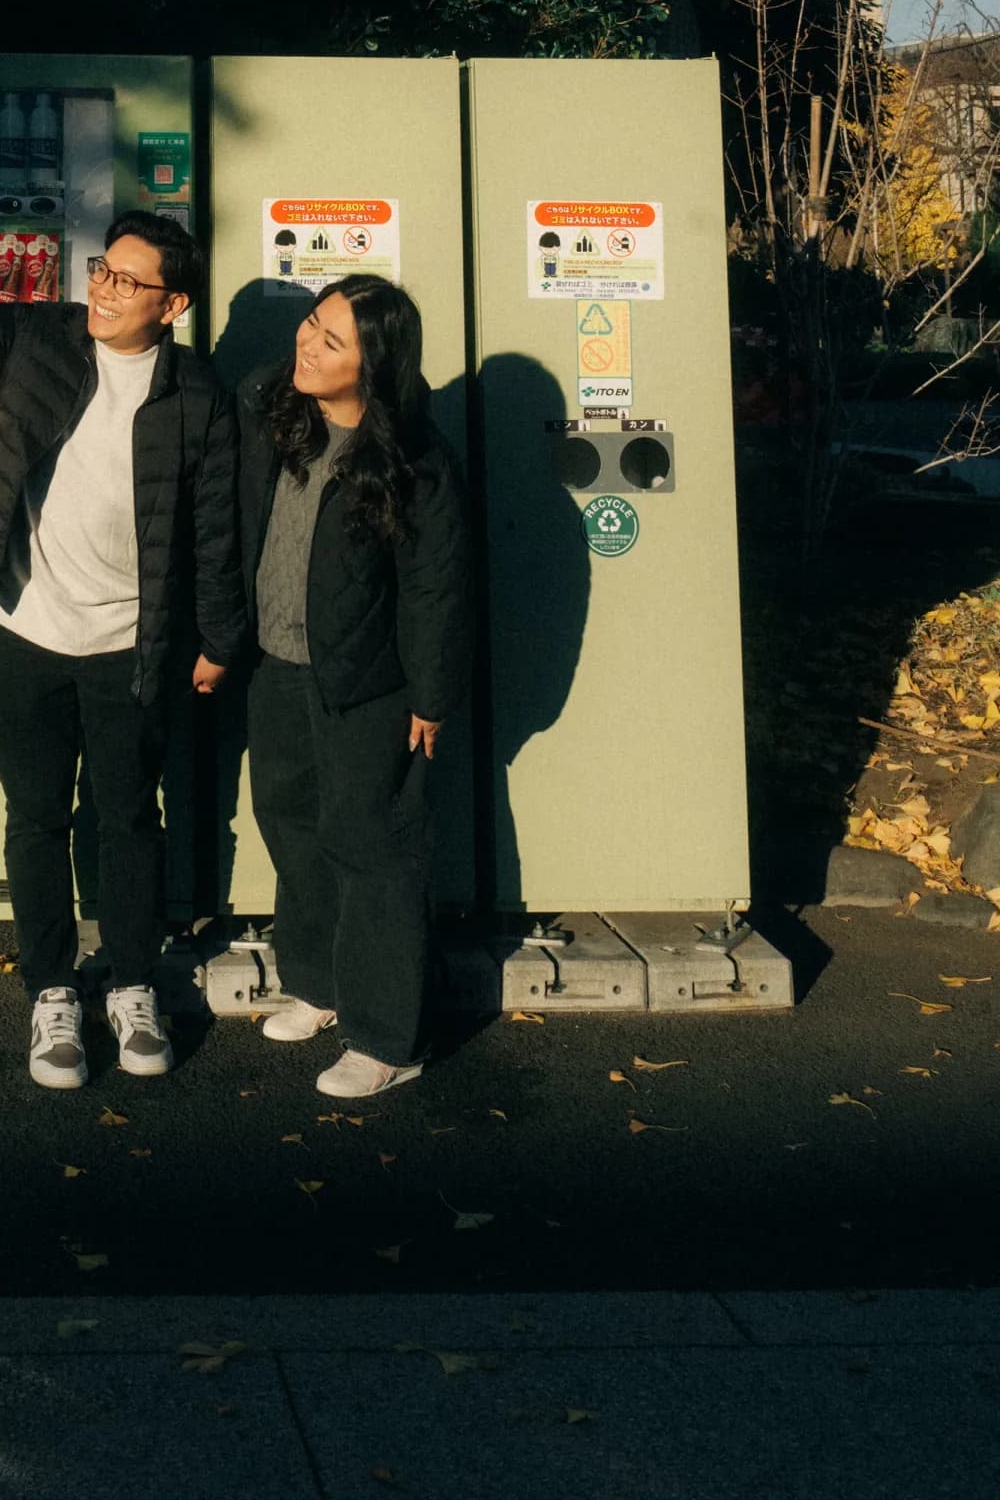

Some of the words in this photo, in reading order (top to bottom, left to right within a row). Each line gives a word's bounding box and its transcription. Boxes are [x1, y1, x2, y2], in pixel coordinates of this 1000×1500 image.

[281, 203, 380, 212] こちらはリサイクルBOXです。
[545, 206, 644, 214] こちらはリサイクルBOXです。
[287, 213, 376, 222] ゴミは入れないで下さい。
[551, 216, 640, 225] ゴミは入れないで下さい。
[595, 388, 614, 396] ITO
[615, 388, 630, 396] EN
[629, 420, 648, 429] カン
[585, 498, 634, 518] RECYCLE
